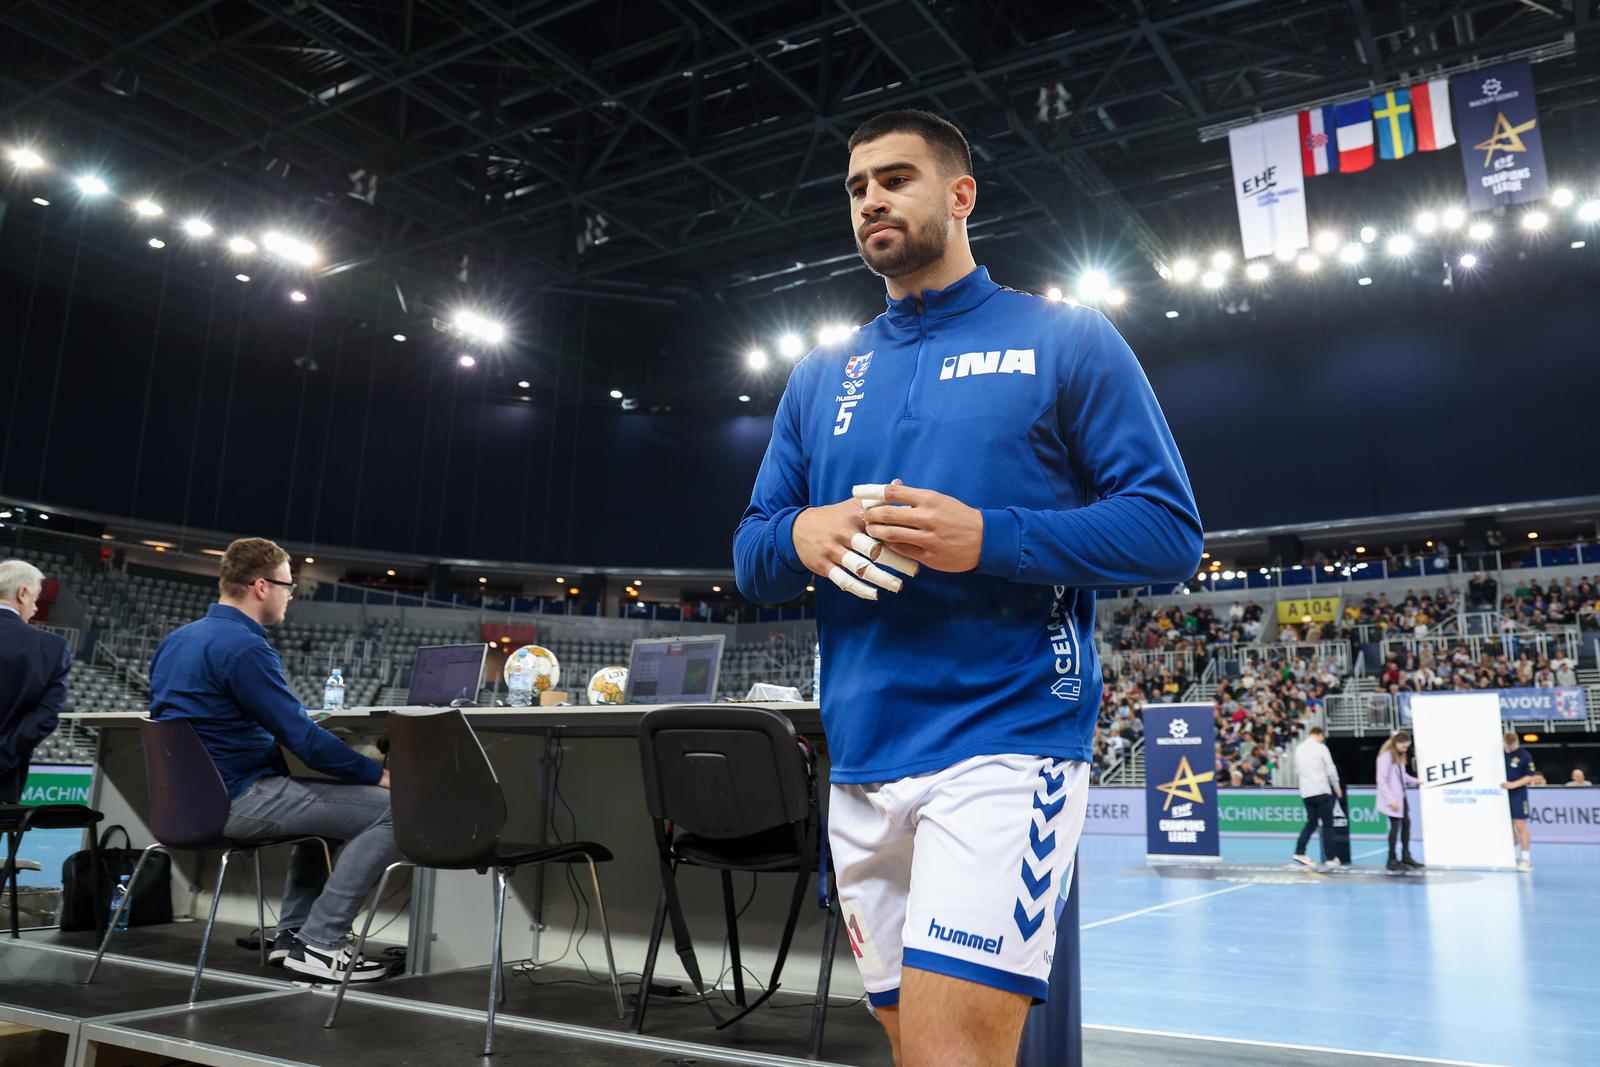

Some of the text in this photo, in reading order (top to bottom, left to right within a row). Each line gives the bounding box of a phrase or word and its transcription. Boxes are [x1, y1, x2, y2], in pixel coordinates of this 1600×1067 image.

[1242, 166, 1277, 193] EHF
[835, 392, 865, 402] hummel
[833, 401, 858, 436] 5
[1288, 601, 1332, 615] A 104
[1426, 756, 1472, 782] EHF
[927, 917, 1004, 955] hummel
